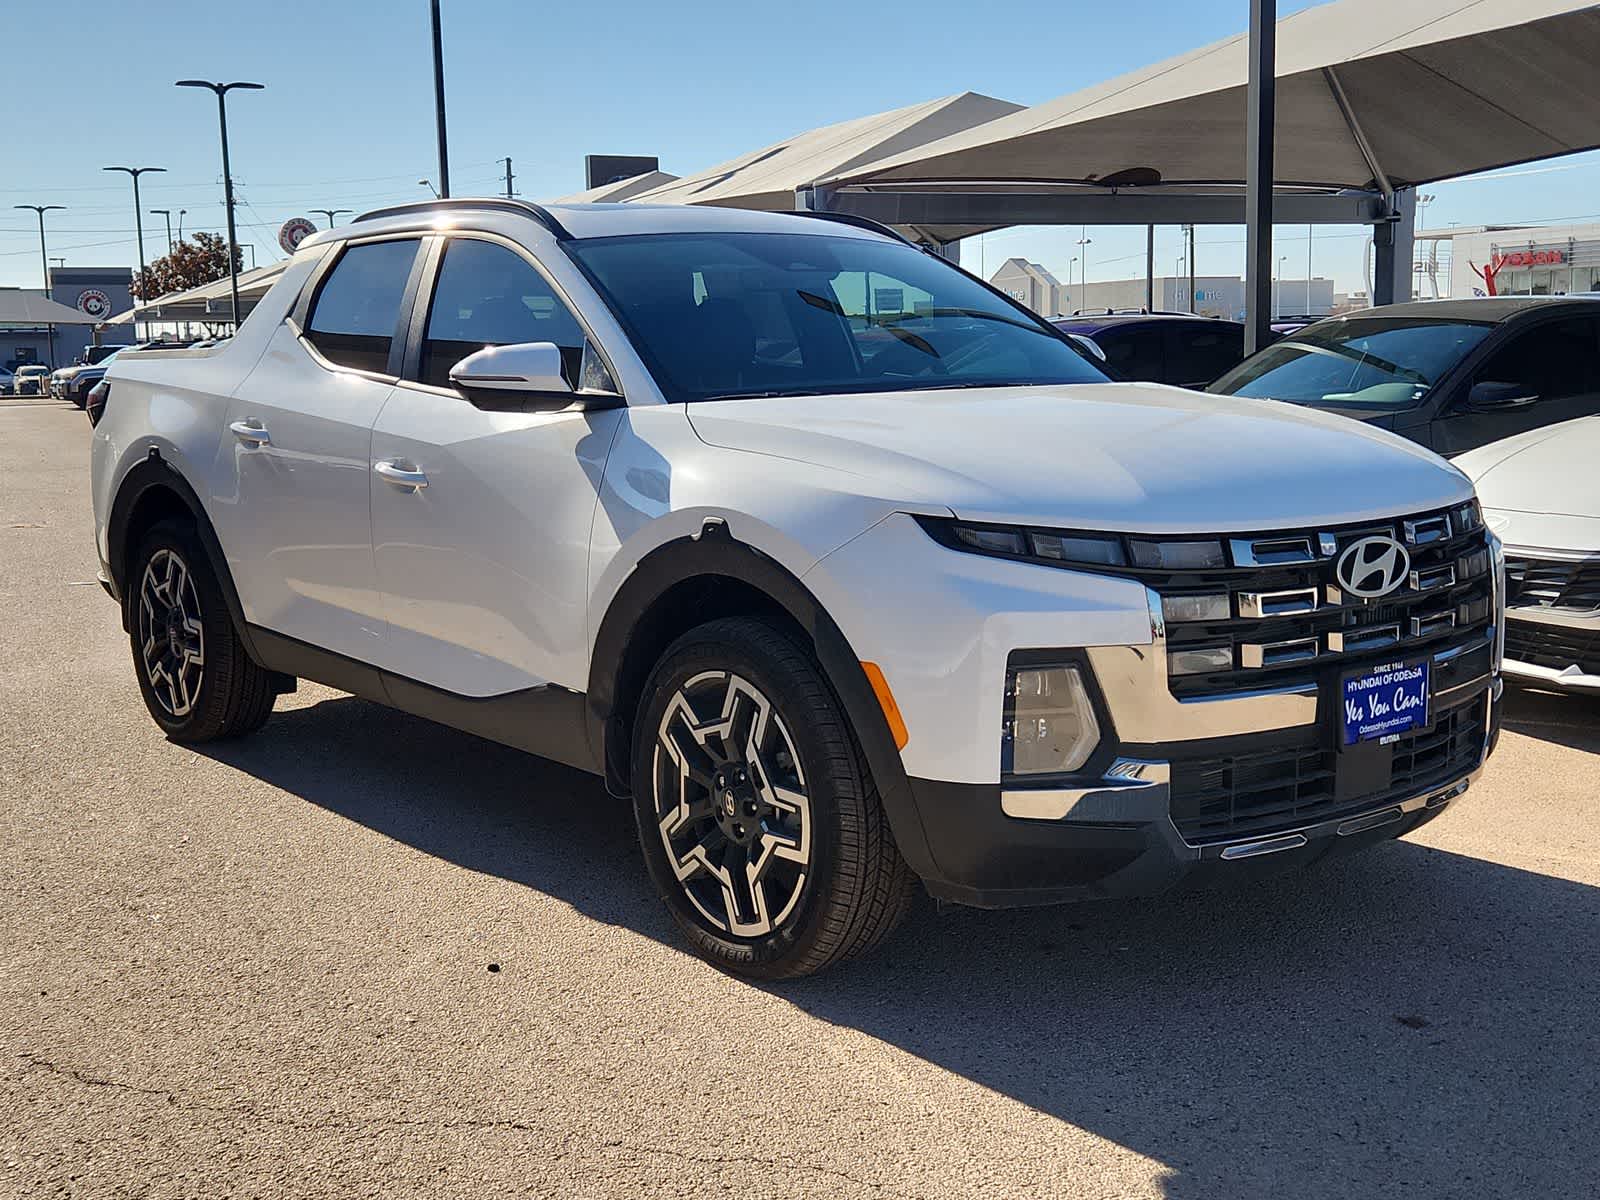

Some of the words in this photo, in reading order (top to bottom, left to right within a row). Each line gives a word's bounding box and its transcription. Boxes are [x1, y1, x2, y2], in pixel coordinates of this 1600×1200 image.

[1374, 664, 1391, 673] SINCE
[1347, 676, 1382, 692] HYUNDAI
[1382, 673, 1393, 685] OF
[1393, 668, 1422, 681] ODESSA
[1345, 698, 1364, 724] Yes
[1369, 693, 1390, 718] You
[1394, 682, 1424, 711] Can!
[1359, 716, 1412, 733] OdessaHyundai.com
